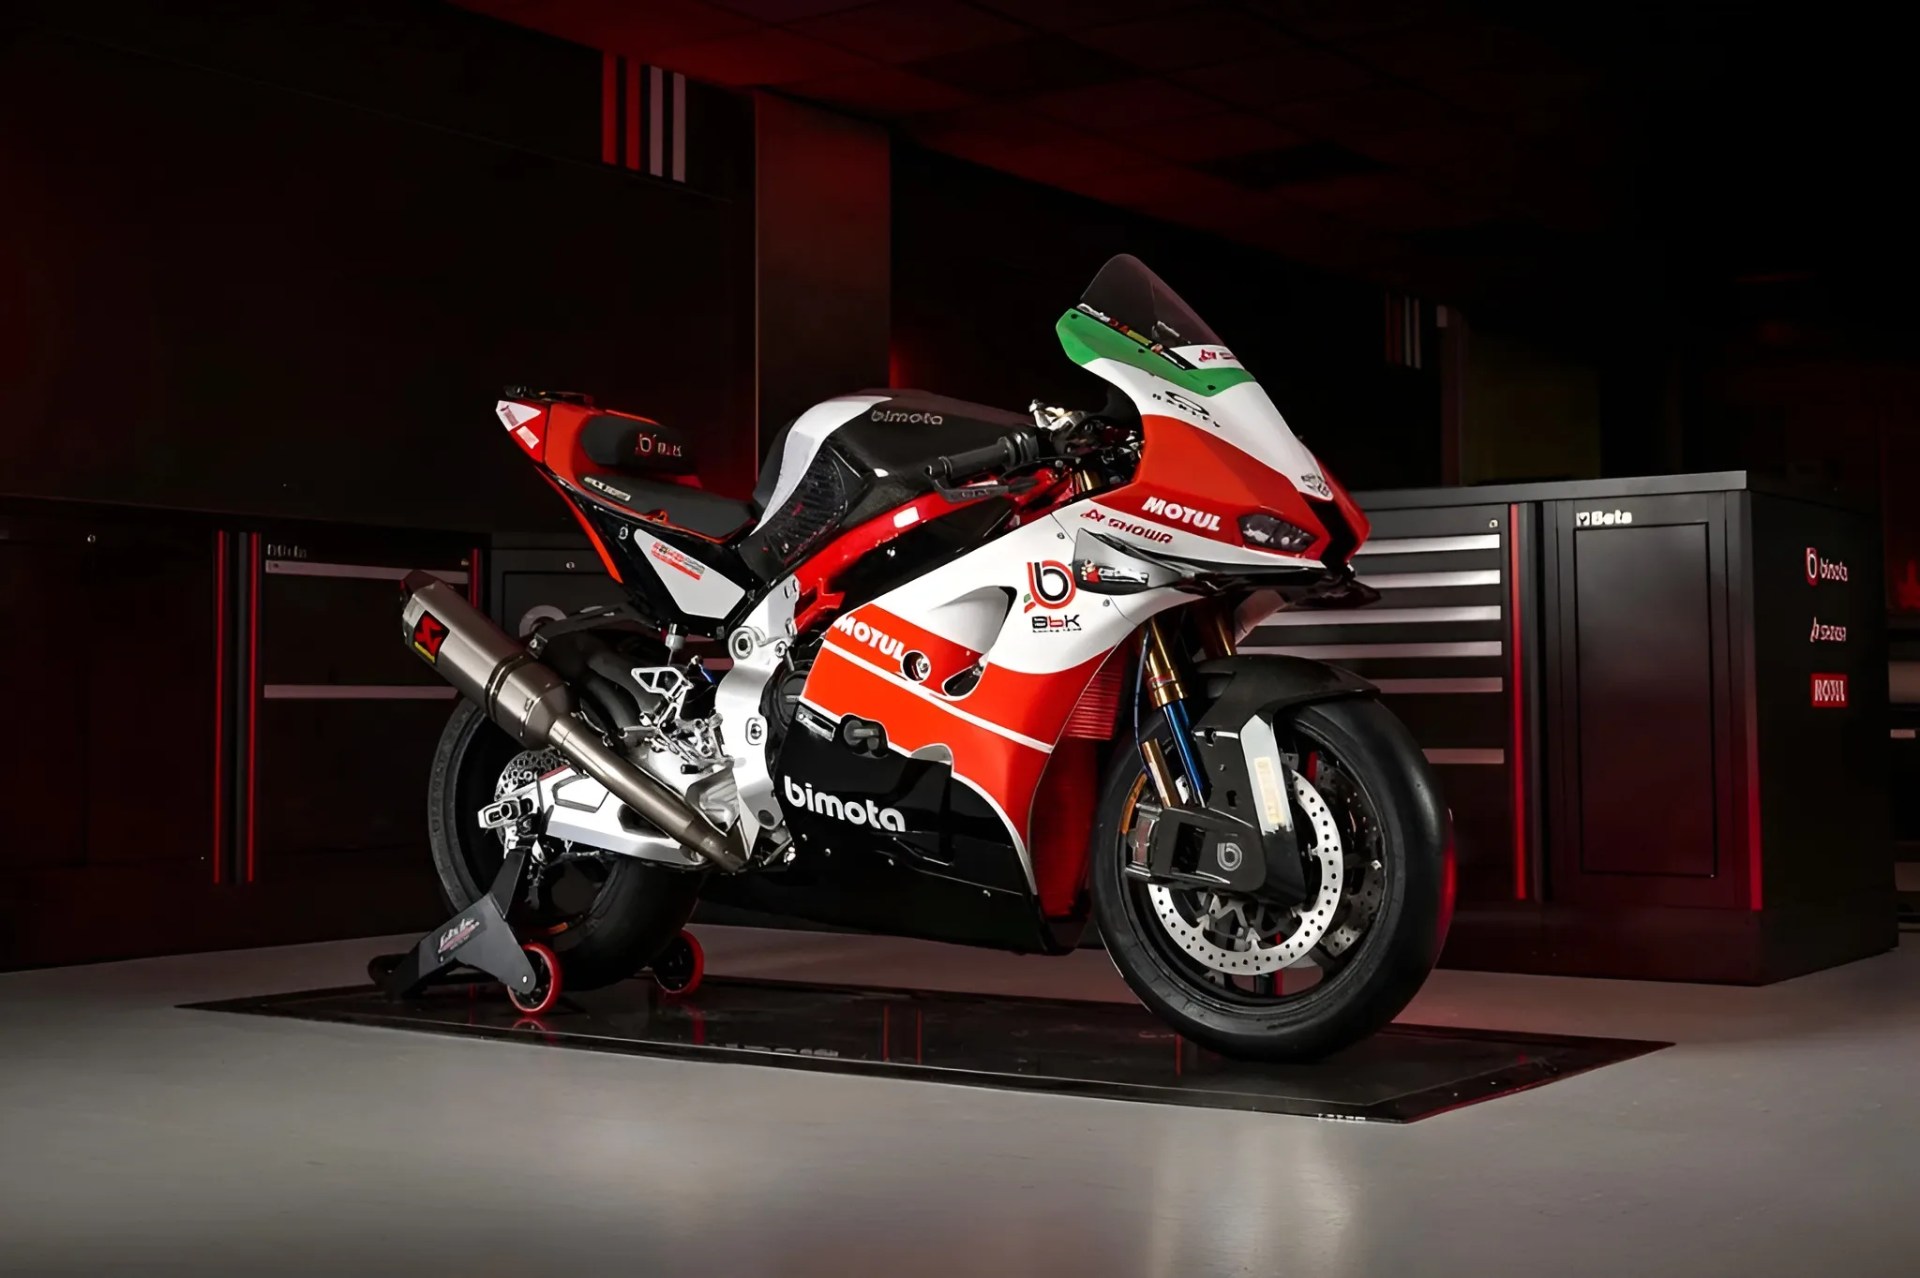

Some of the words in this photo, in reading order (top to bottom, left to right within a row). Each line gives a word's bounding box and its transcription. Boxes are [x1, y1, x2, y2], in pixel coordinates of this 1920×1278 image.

[871, 409, 943, 426] bimota
[1108, 517, 1174, 545] SHOWA
[1141, 497, 1221, 531] MOTUL
[835, 615, 906, 662] MOTUL
[784, 775, 906, 833] bimota
